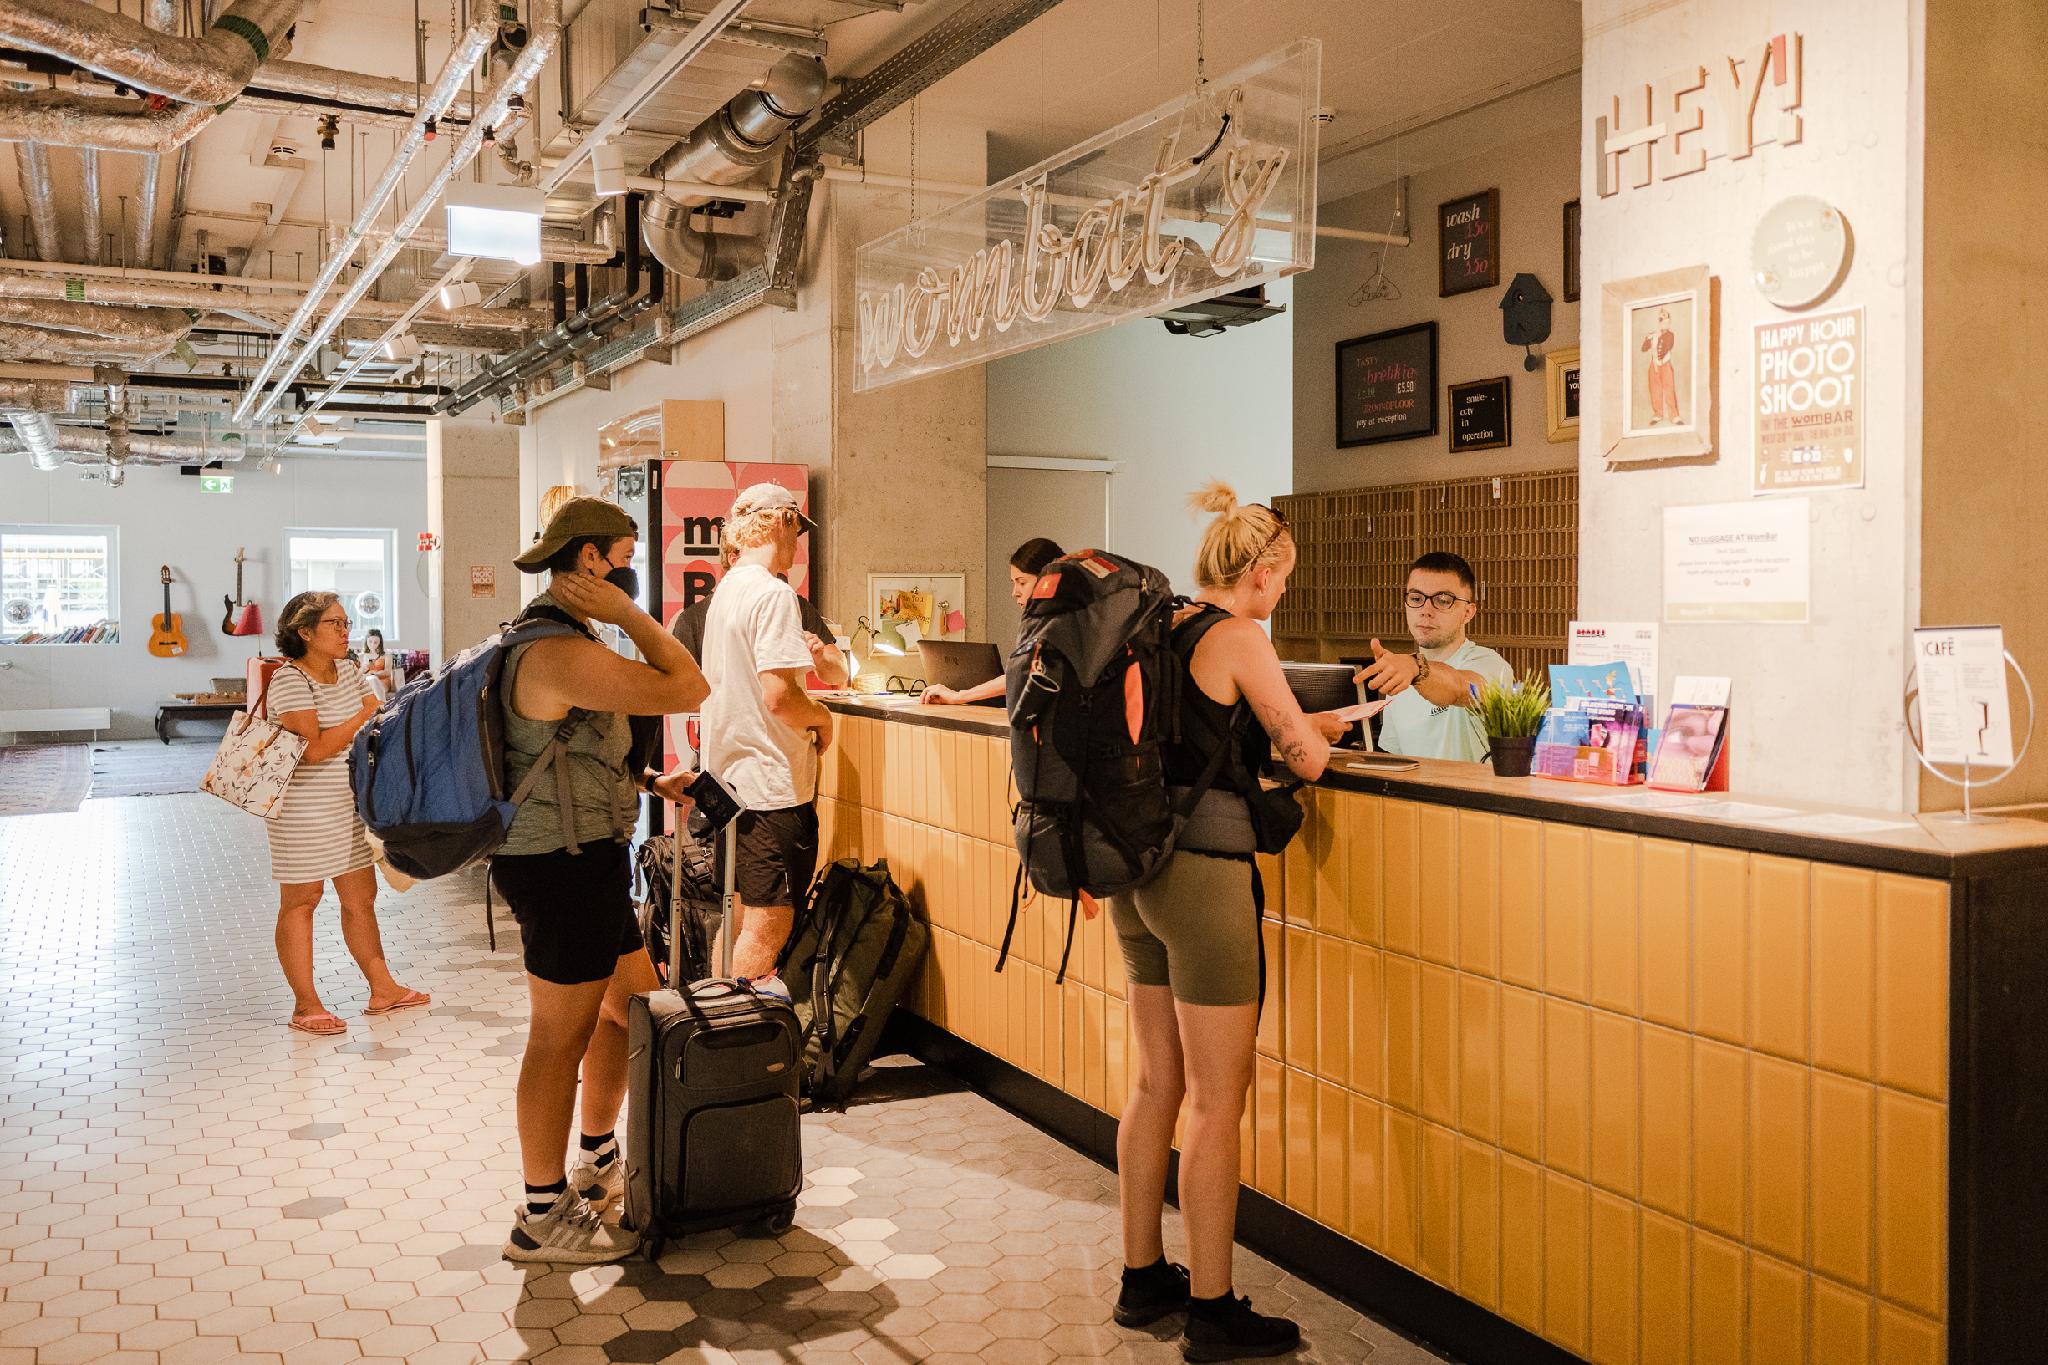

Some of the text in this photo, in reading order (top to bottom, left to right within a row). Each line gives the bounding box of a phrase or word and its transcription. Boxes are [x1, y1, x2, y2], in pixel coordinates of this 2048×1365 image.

[1596, 32, 1803, 198] HEY!
[1446, 203, 1480, 227] wash
[1447, 242, 1472, 260] dry
[1760, 316, 1856, 349] HAPPY HOUR
[1760, 340, 1856, 383] PHOTO
[1760, 373, 1856, 416] SHOOT
[1377, 412, 1407, 424] reception
[1461, 418, 1470, 427] in
[1462, 429, 1494, 442] operation
[1688, 536, 1699, 545] NO
[1701, 535, 1734, 544] LUGGAGE
[1736, 534, 1745, 542] AT
